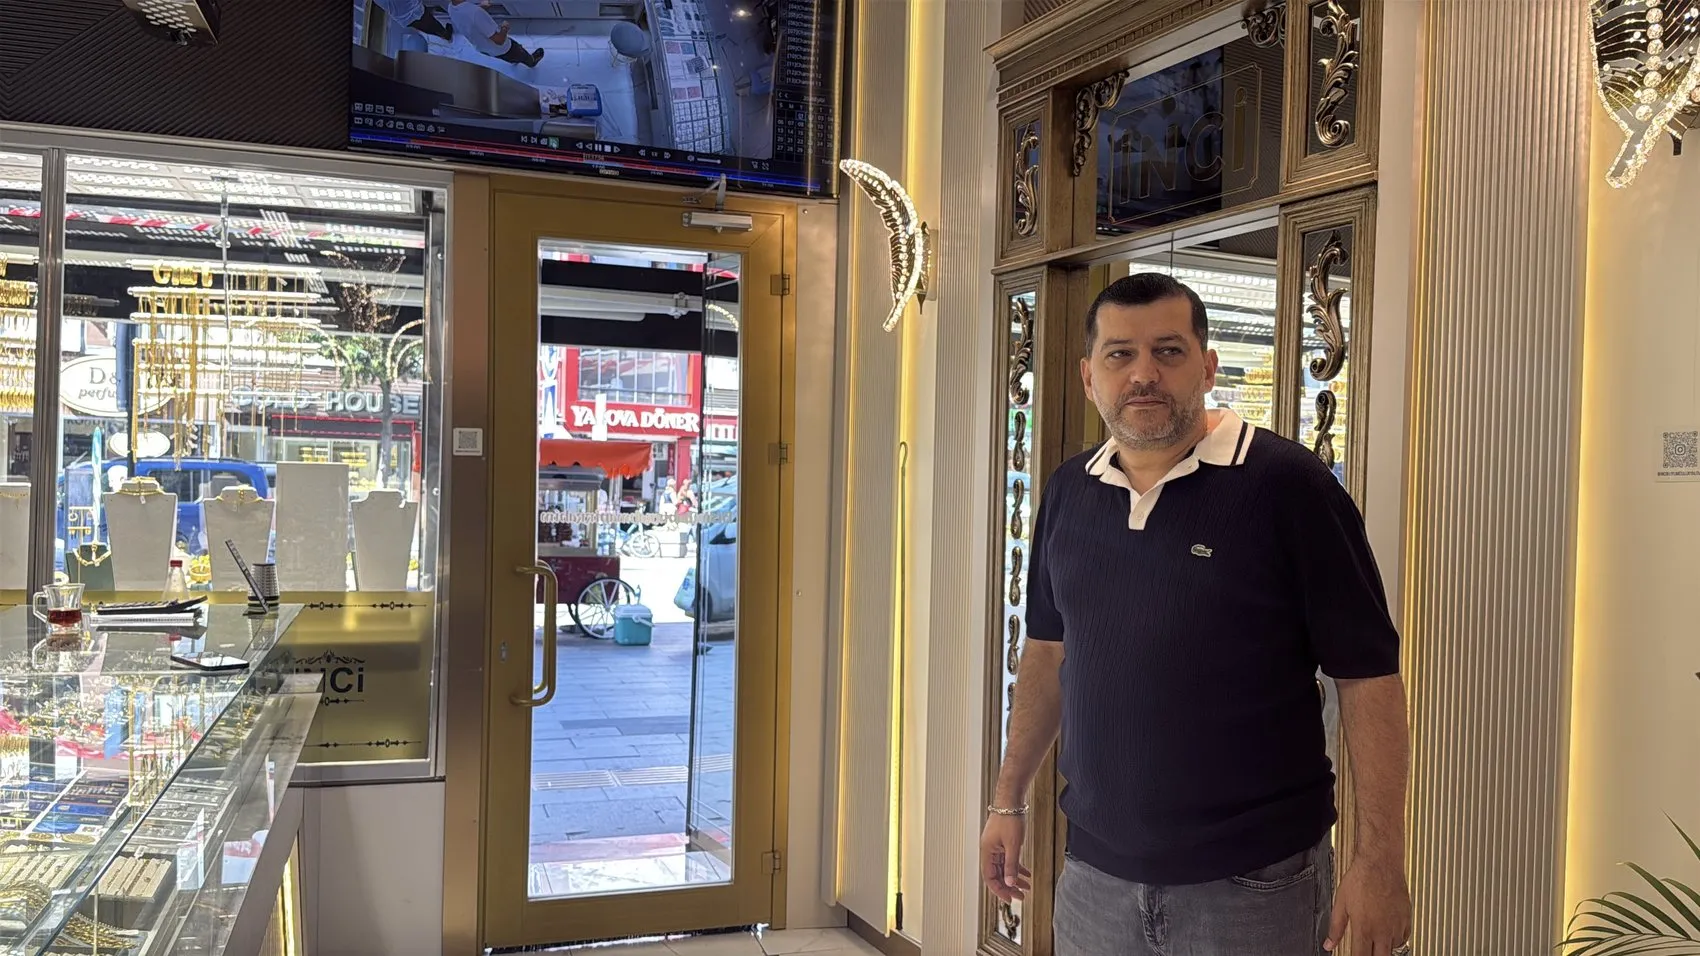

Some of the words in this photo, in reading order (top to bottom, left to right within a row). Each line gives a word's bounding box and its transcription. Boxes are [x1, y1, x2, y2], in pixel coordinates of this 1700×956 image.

[89, 367, 106, 384] D
[78, 386, 116, 400] perfu
[570, 405, 640, 428] YAOVA
[641, 407, 700, 433] DÖNER
